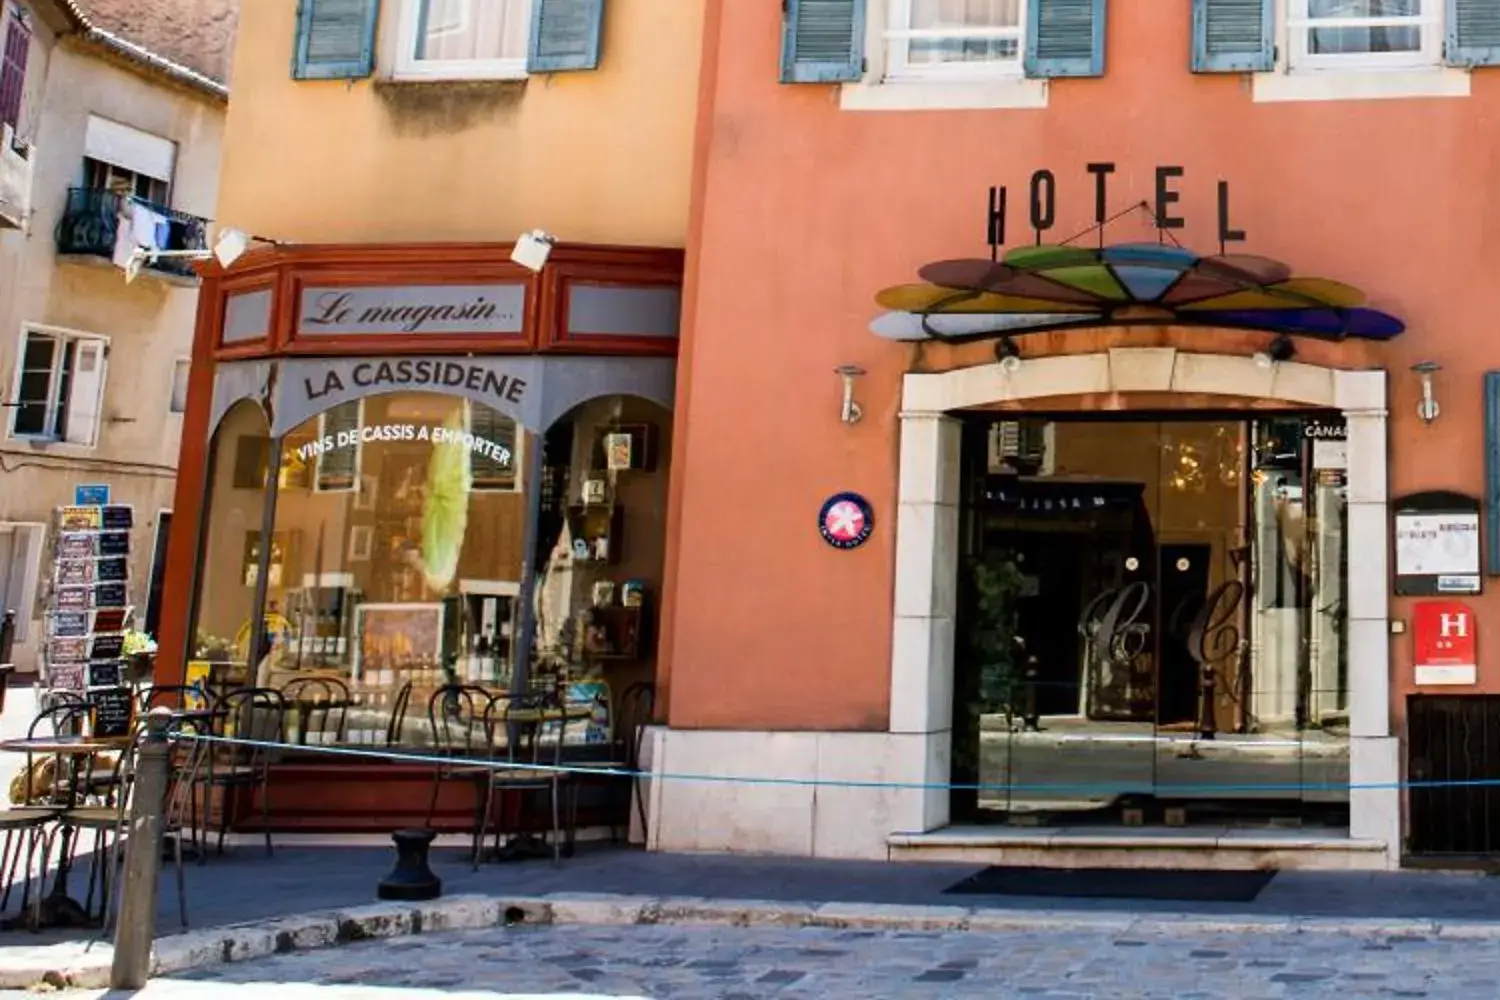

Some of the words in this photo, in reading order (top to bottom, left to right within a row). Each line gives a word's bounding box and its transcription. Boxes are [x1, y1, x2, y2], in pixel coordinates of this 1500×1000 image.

[987, 162, 1246, 246] HOTEL
[303, 291, 355, 326] Le
[304, 369, 345, 401] LA
[352, 359, 528, 405] CASSIDENE
[297, 434, 334, 462] VINS
[336, 429, 358, 448] DE
[361, 424, 415, 442] CASSIS
[416, 424, 429, 441] A
[431, 426, 511, 466] EMPORTER
[1439, 612, 1469, 638] H
